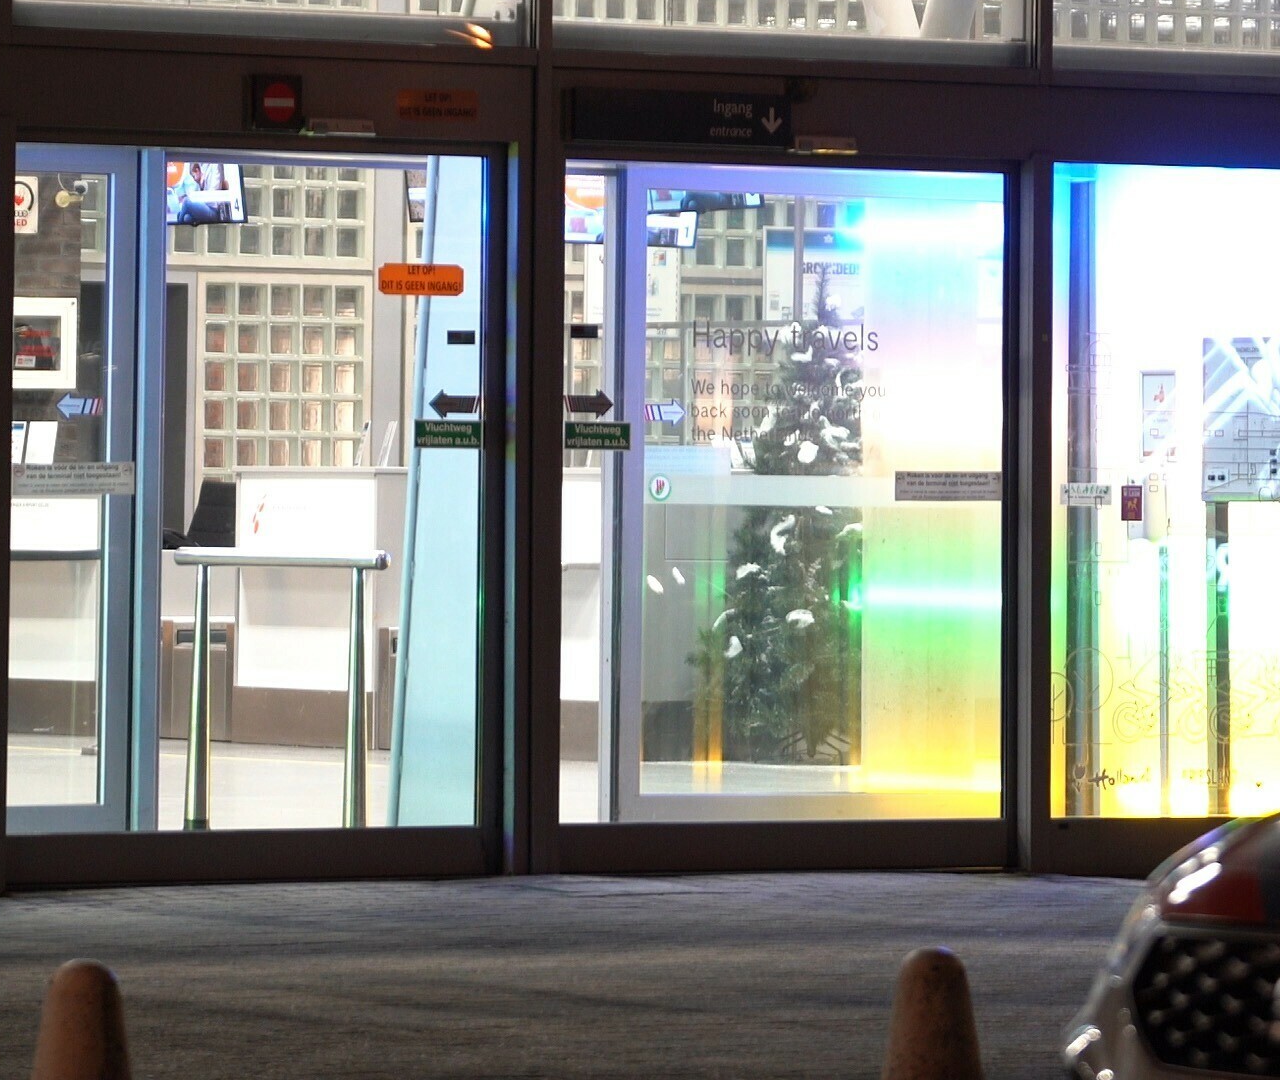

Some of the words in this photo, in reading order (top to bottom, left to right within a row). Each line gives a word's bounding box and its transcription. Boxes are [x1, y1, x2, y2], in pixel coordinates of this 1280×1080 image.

[424, 92, 436, 102] LET
[713, 99, 753, 118] Ingang
[710, 126, 752, 137] entrance
[408, 265, 420, 275] LET
[422, 266, 436, 275] OP!
[381, 280, 394, 290] DIT
[396, 281, 403, 290] IS
[405, 281, 425, 290] GEEN
[427, 281, 461, 292] INGANG!
[693, 320, 780, 356] Happy
[791, 324, 879, 351] travels
[691, 379, 715, 395] We
[721, 379, 759, 400] hope
[765, 380, 780, 396] to
[858, 385, 886, 401] you
[691, 404, 727, 418] back
[734, 407, 770, 419] soon
[424, 422, 473, 435] Vluchtweg
[574, 424, 621, 436] Vluchtweg
[691, 427, 715, 441] the
[417, 435, 453, 447] vrijlaten
[455, 436, 480, 446] a.u.b.
[566, 436, 602, 449] vrijlaten
[604, 437, 629, 448] a.u.b.
